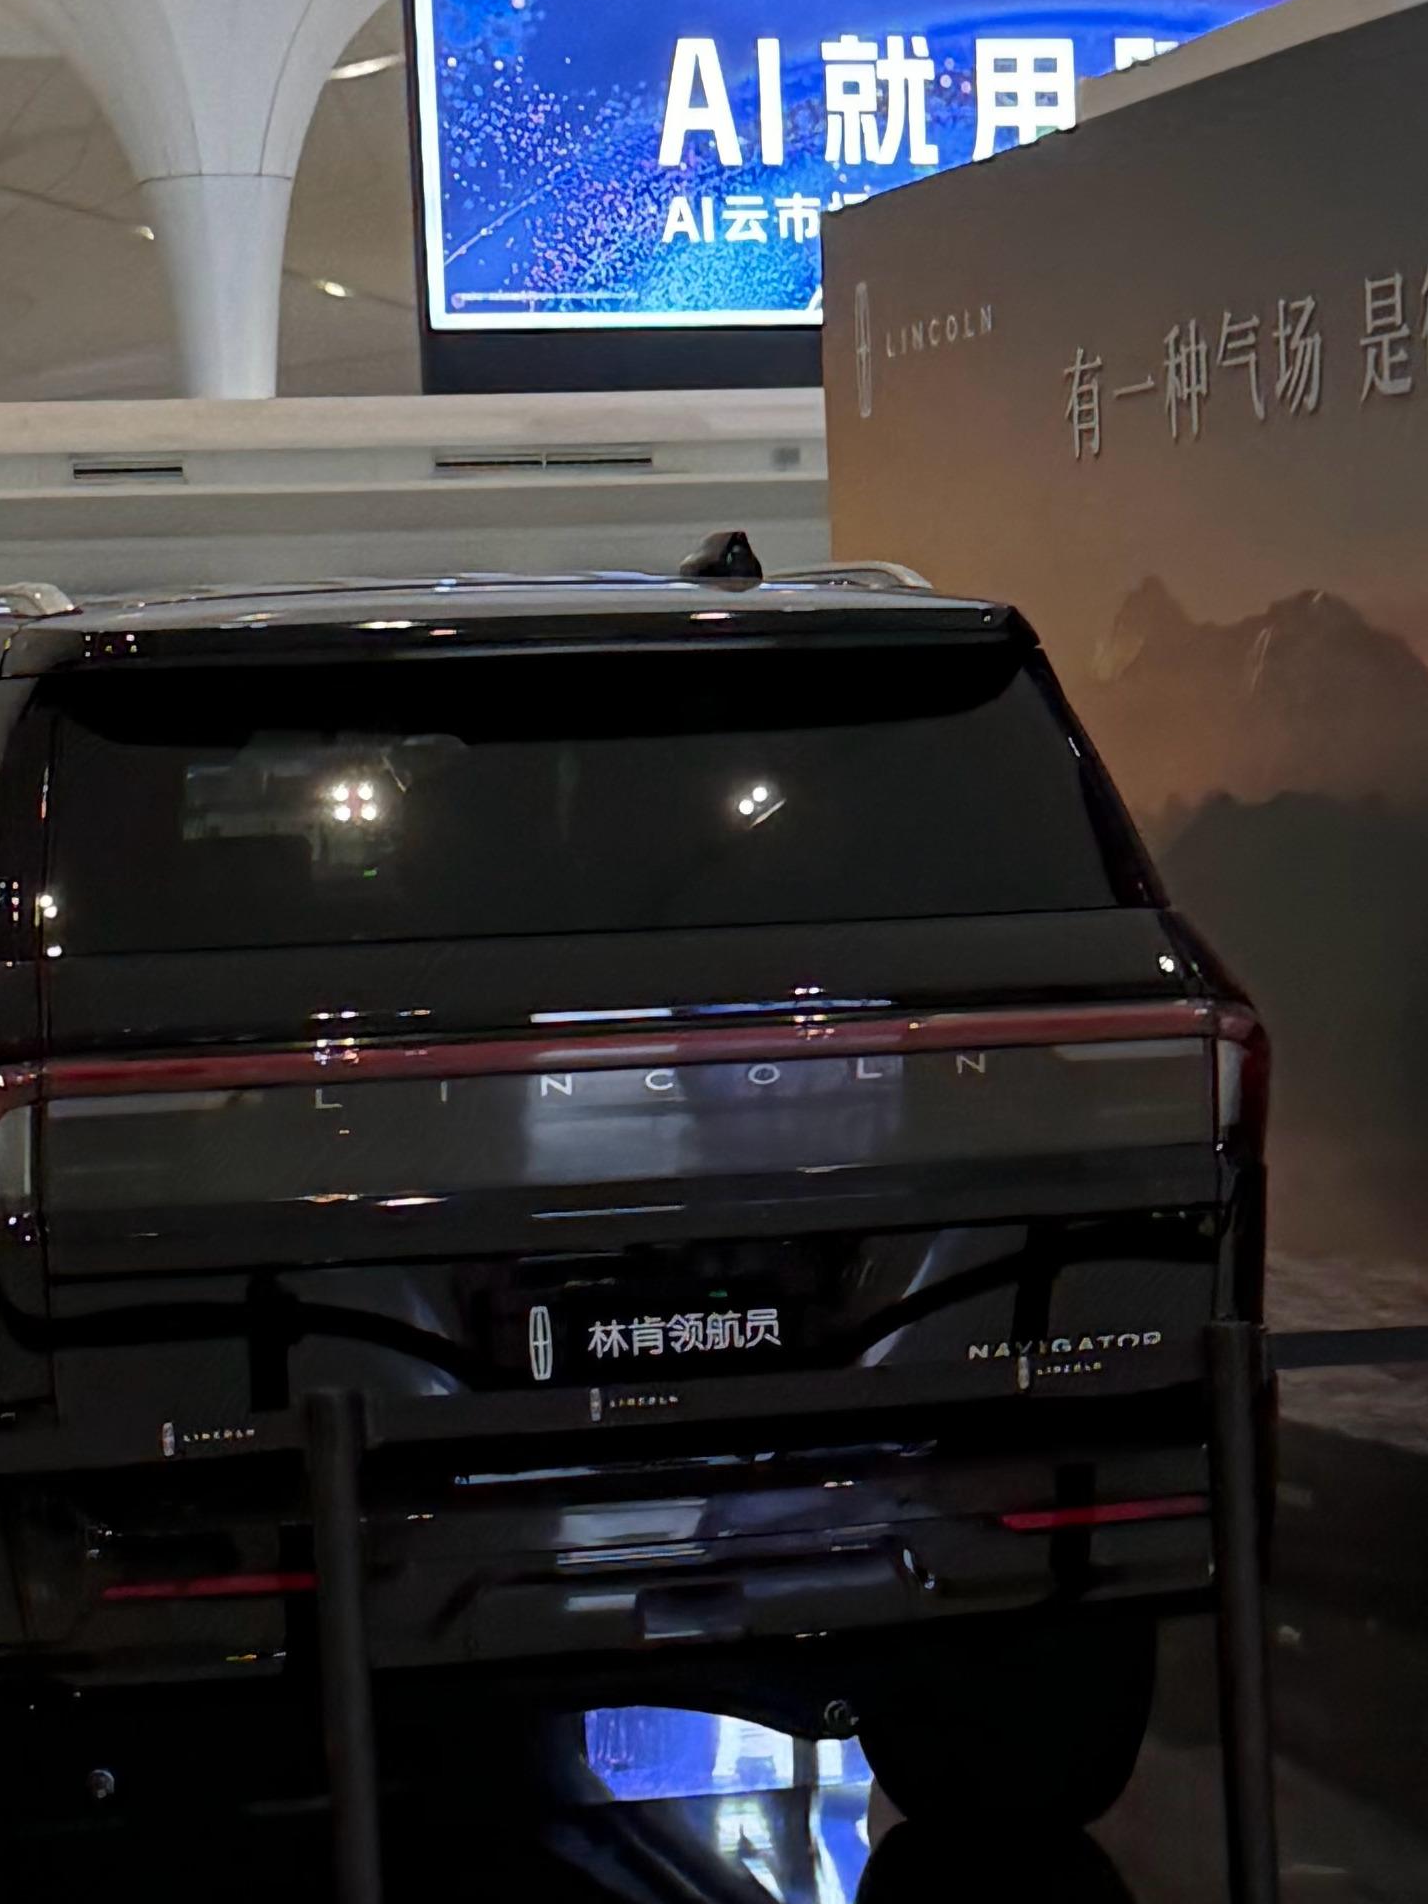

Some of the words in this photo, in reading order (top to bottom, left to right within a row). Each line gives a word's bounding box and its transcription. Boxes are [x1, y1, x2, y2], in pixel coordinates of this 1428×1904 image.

[658, 33, 1178, 167] AI就用
[661, 192, 870, 244] AI云市
[885, 303, 993, 359] LINCOLN
[1062, 295, 1323, 460] 有一种气场
[314, 1051, 987, 1110] LINCOLN
[586, 1307, 782, 1360] 林肯领航员
